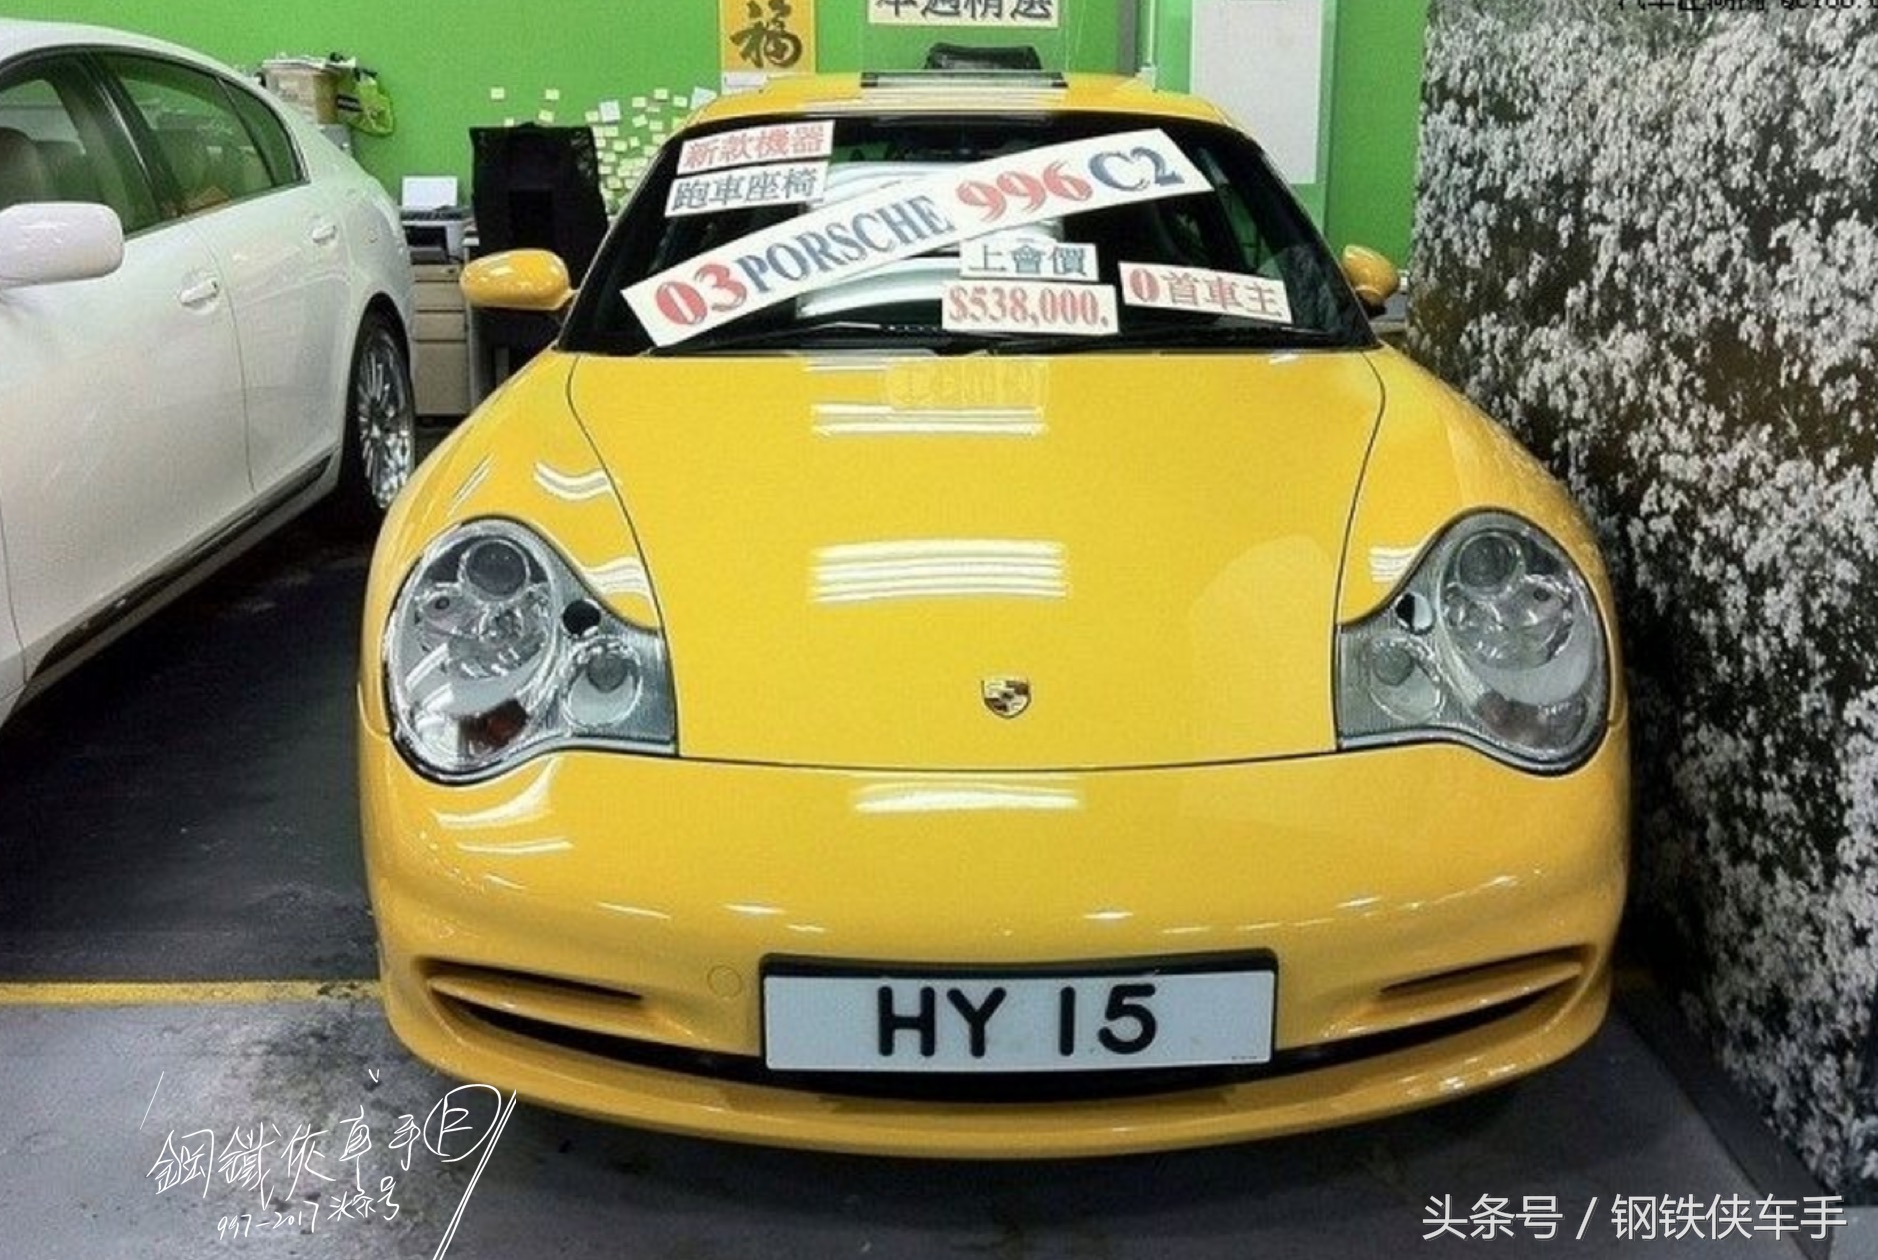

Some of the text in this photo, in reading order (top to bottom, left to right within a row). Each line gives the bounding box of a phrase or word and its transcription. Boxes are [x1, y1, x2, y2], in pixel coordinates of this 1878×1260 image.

[684, 125, 824, 169] 新款機器
[671, 168, 819, 211] 跑車座椅
[968, 243, 1087, 276] 上會價
[877, 983, 1156, 1058] HY 15
